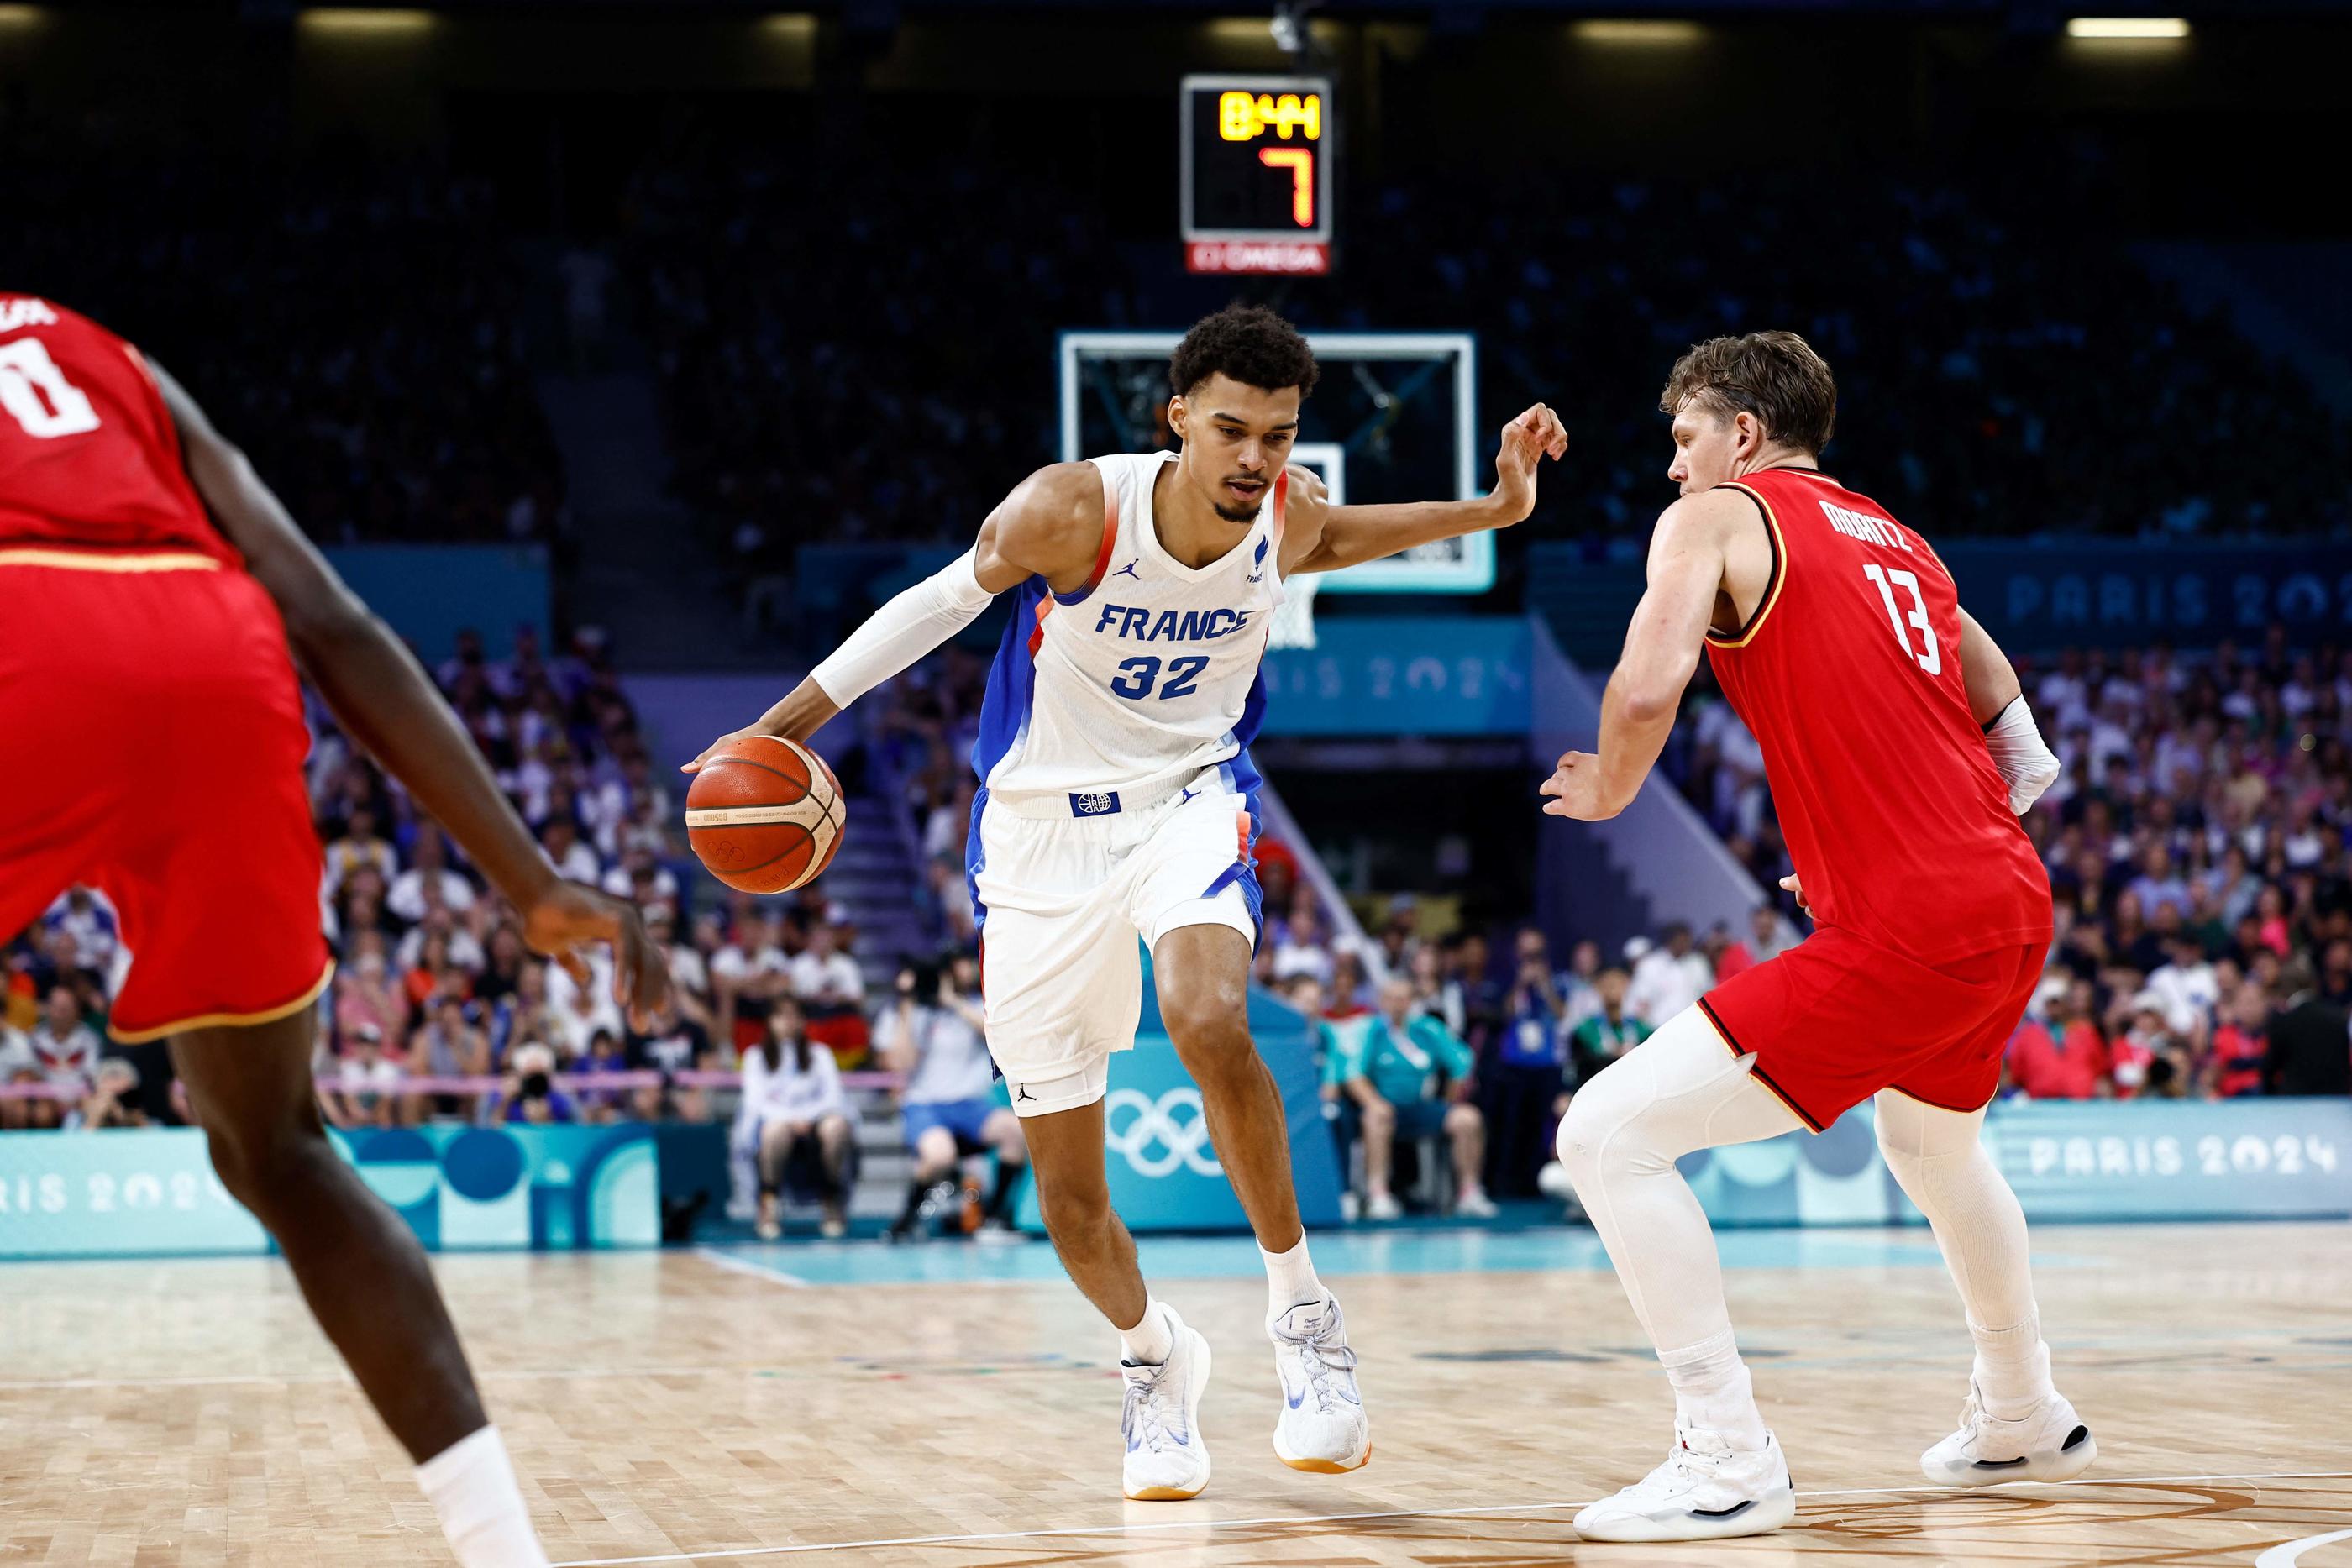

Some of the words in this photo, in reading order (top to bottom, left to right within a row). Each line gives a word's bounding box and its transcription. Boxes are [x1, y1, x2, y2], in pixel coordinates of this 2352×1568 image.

[1219, 91, 1320, 141] 8:44
[1258, 147, 1313, 228] 7
[1818, 500, 1913, 553] MORITZ
[1095, 604, 1256, 642] FRANCE
[1862, 564, 1941, 676] 13
[2008, 573, 2209, 627] PARIS
[1110, 655, 1210, 700] 32
[1368, 657, 1525, 699] 2024
[2029, 1135, 2183, 1177] PARIS
[2197, 1134, 2339, 1177] 2024
